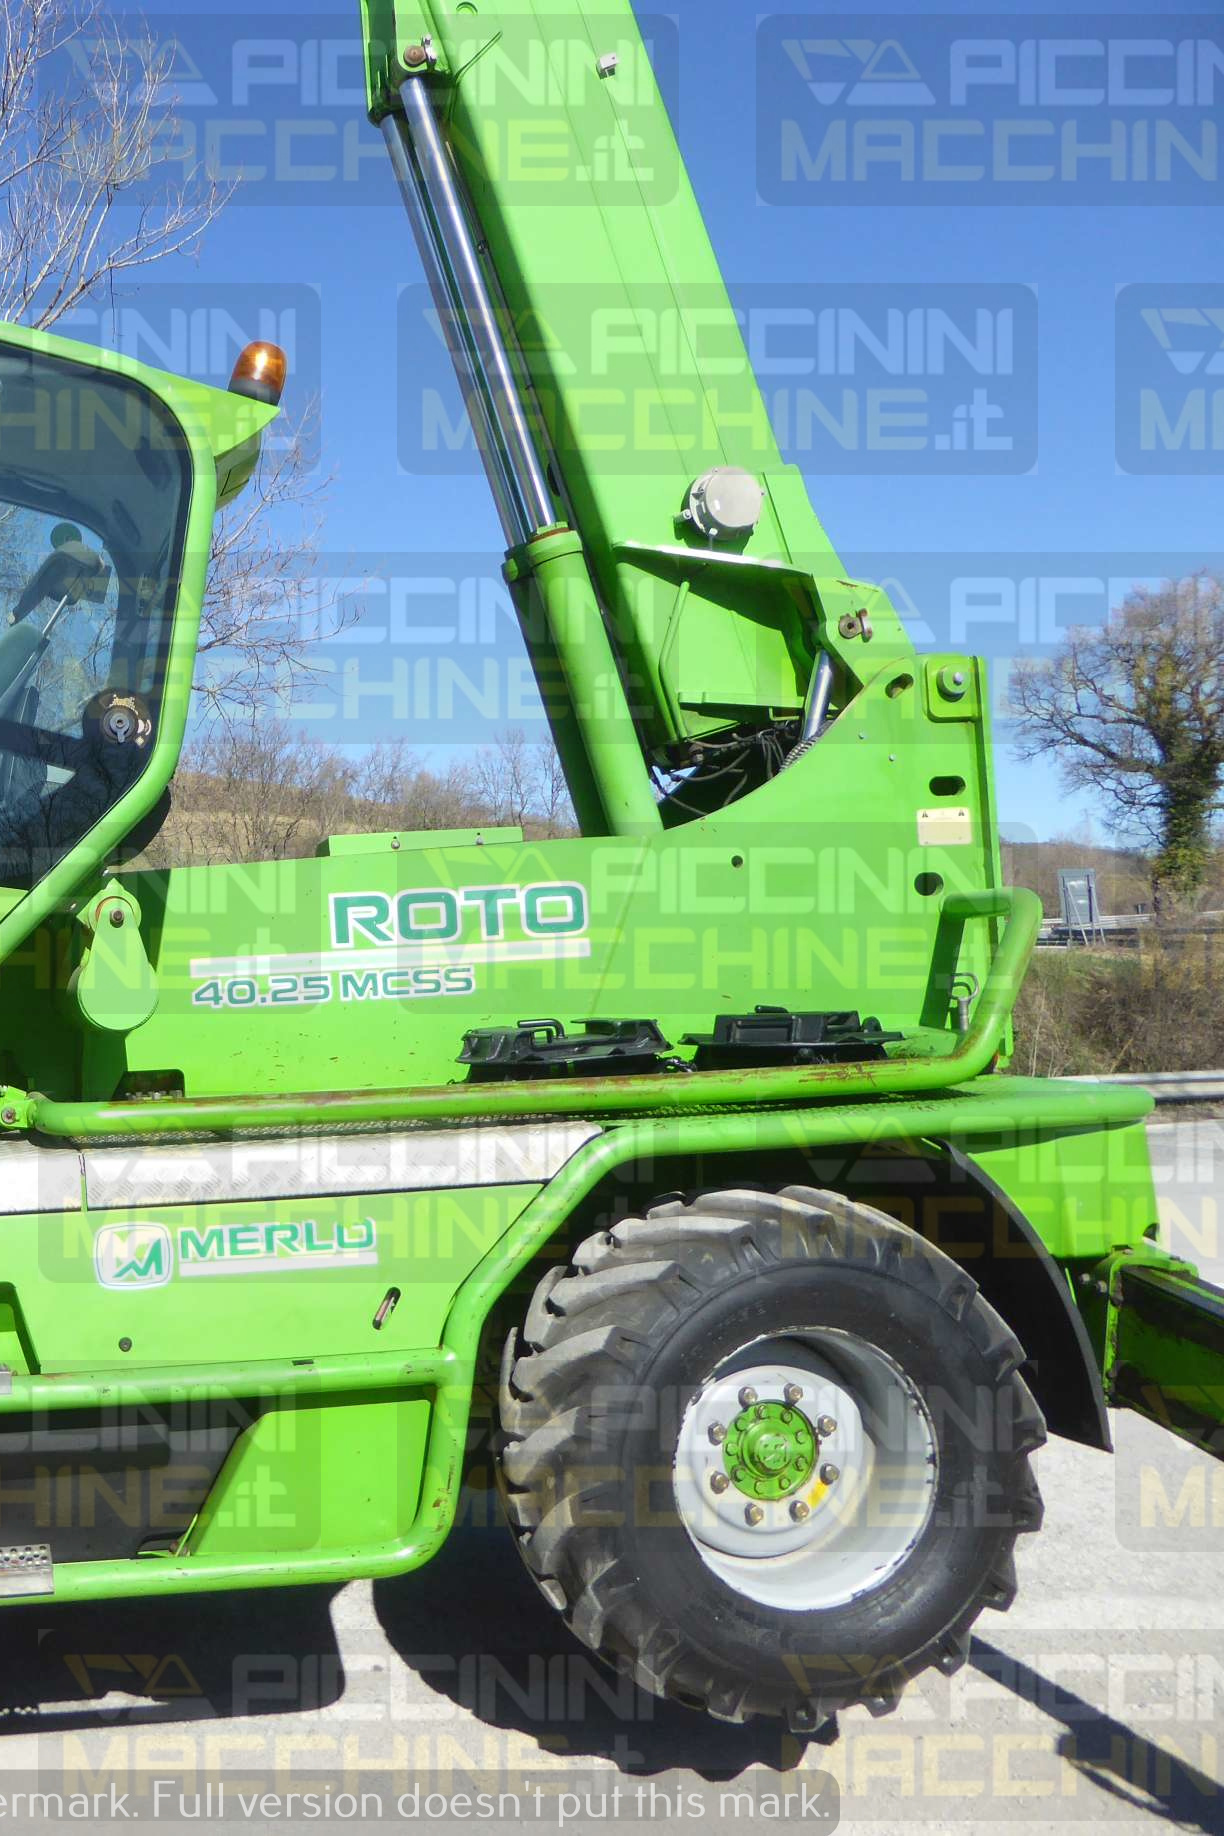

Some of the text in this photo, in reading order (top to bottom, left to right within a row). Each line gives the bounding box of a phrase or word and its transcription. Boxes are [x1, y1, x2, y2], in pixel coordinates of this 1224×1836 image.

[331, 884, 585, 945] ROTO
[194, 967, 473, 1005] 40.25 MCSS
[179, 1220, 376, 1259] MERLO
